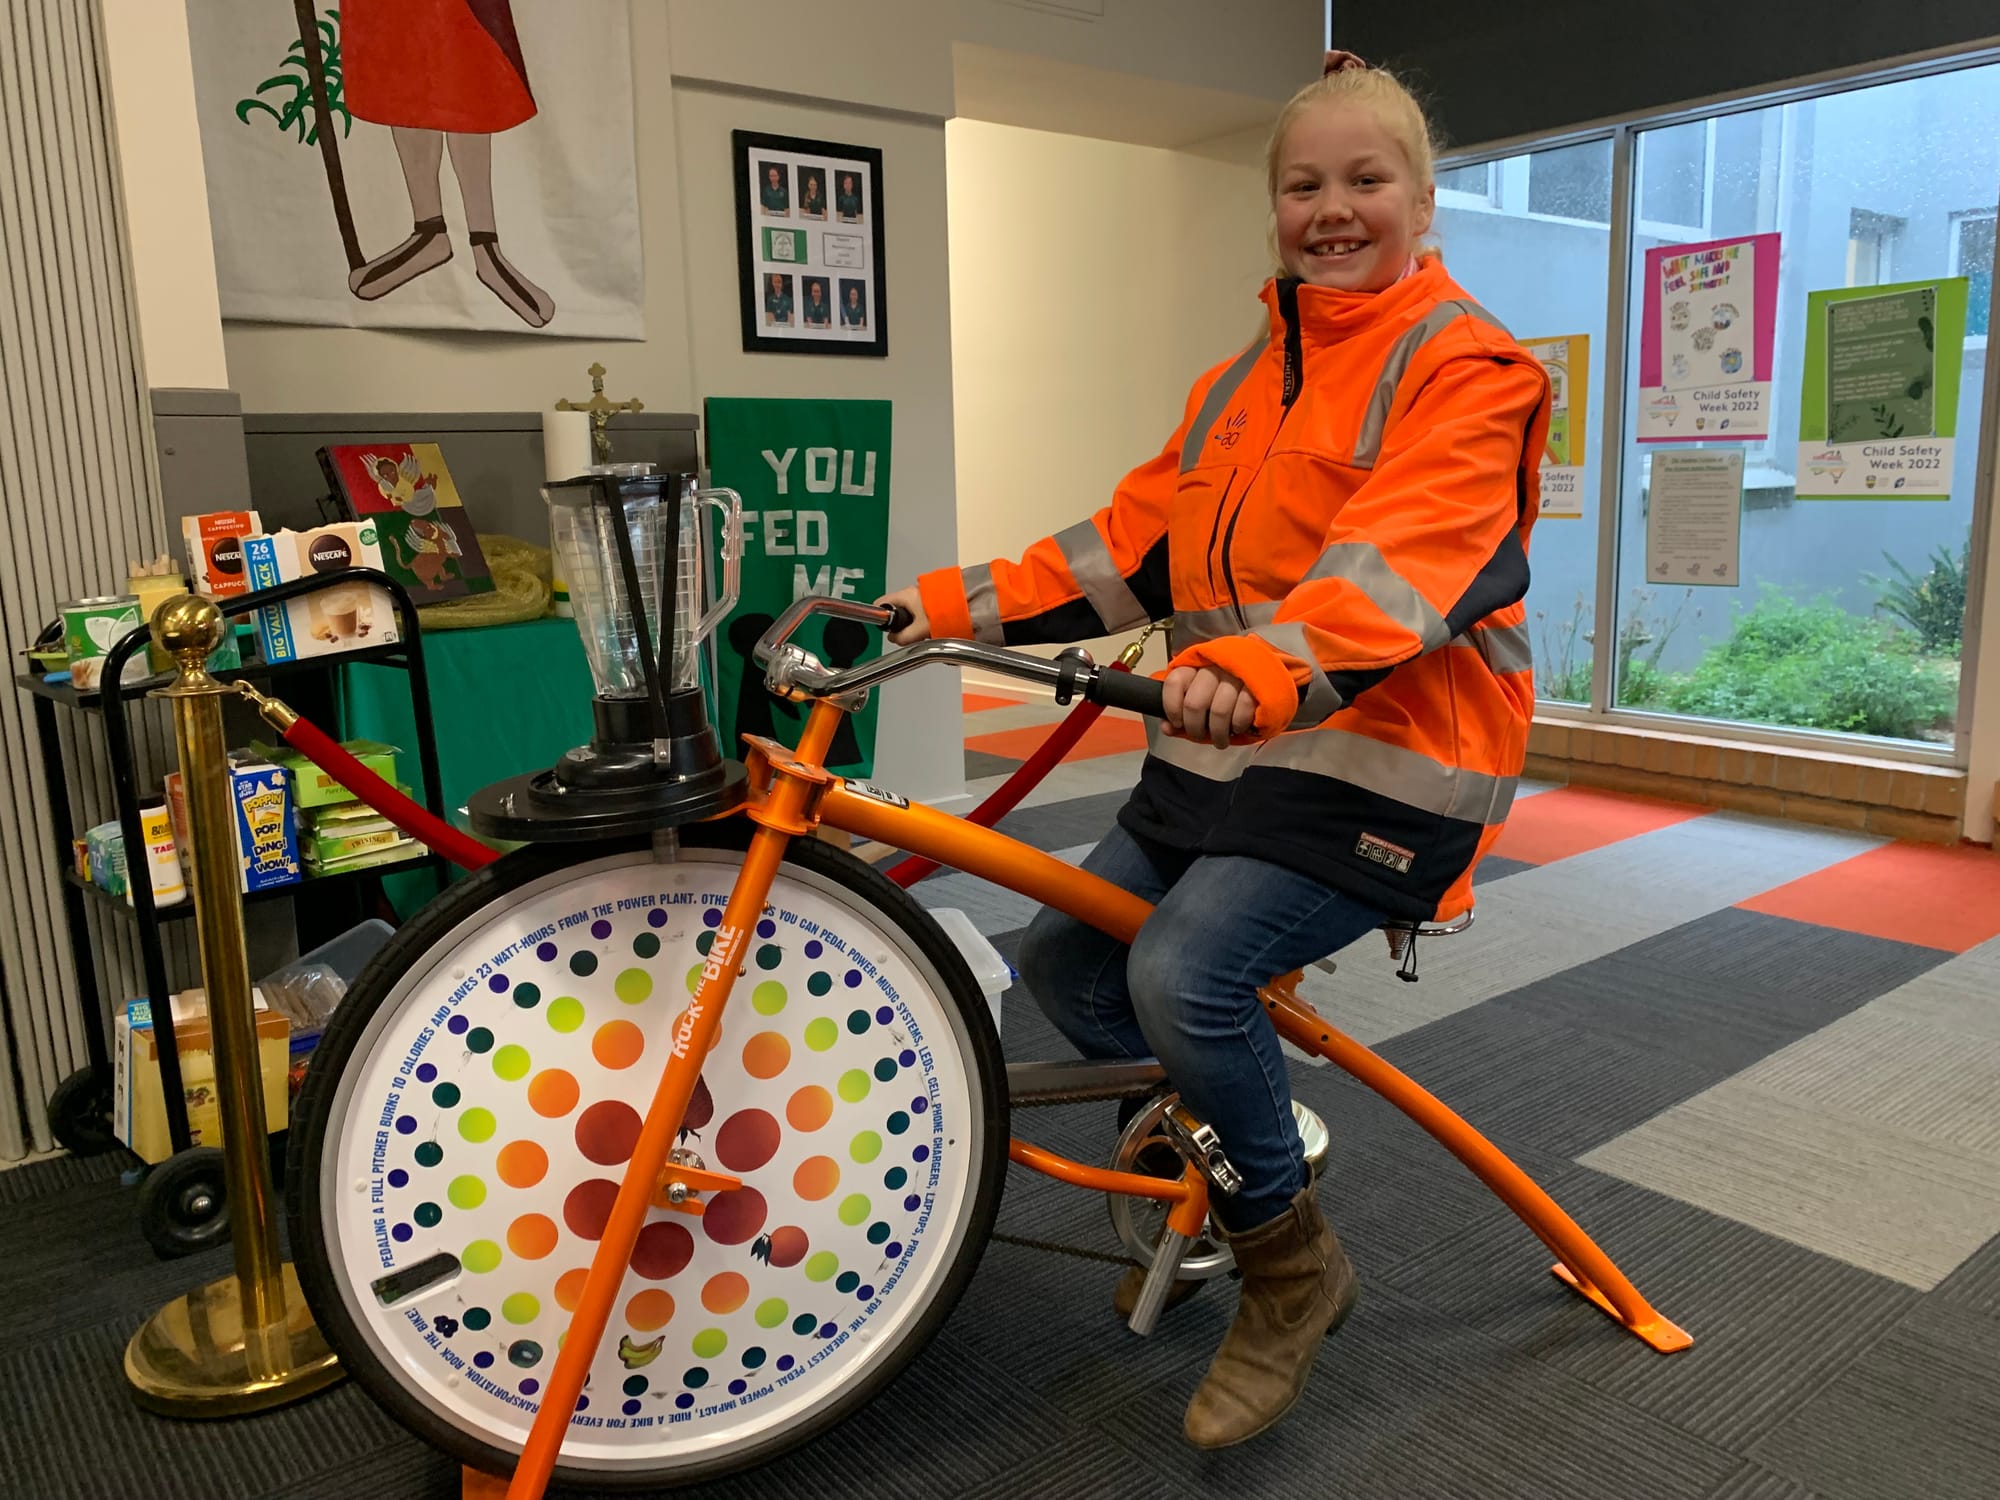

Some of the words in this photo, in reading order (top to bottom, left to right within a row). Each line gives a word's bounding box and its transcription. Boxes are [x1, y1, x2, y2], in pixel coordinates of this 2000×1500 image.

[1693, 390, 1721, 400] Child
[1724, 388, 1760, 400] Safety
[1699, 402, 1728, 412] Week
[1732, 401, 1760, 411] 2022
[1862, 446, 1895, 457] Child
[1900, 445, 1942, 457] Safety
[761, 447, 877, 496] YOU
[1870, 459, 1903, 469] Week
[1909, 459, 1941, 469] 2022
[1545, 472, 1575, 481] Safety
[1552, 483, 1574, 492] 2022
[740, 510, 829, 556] FED
[215, 552, 241, 561] NESCA
[251, 542, 269, 554] 26
[313, 547, 348, 562] NESCAFÉ
[213, 580, 246, 589] CAPPUCC
[259, 562, 272, 588] ACK
[268, 602, 282, 636] VALU
[273, 637, 287, 658] BIG
[254, 823, 281, 838] POP!
[256, 857, 290, 873] WOW!
[617, 895, 656, 912] POWER
[659, 893, 697, 905] PLANT.
[701, 894, 729, 907] OTHE
[557, 910, 589, 931] FROM
[592, 903, 614, 918] THE
[779, 909, 798, 925] YOU
[799, 918, 820, 935] CAN
[491, 923, 556, 967] WATT-HOURS
[819, 928, 848, 954] PEDAL
[476, 963, 493, 979] 23
[847, 948, 878, 979] POWER:
[448, 976, 478, 1006] SAVES
[672, 1003, 704, 1060] ROCK
[703, 925, 736, 981] BIKE
[875, 975, 900, 1003] MUSIC
[430, 1005, 451, 1028] AND
[896, 1002, 923, 1047] SYSTEMS,
[400, 1026, 435, 1076] CALORIES
[918, 1046, 934, 1076] LEDS,
[392, 1076, 407, 1089] 10
[927, 1076, 941, 1101] CELL
[379, 1092, 400, 1128] BURNS
[932, 1103, 943, 1134] PHONE
[372, 1131, 389, 1173] PITCHER
[926, 1137, 943, 1189] CHARGERS,
[372, 1177, 384, 1203] FULL
[912, 1193, 936, 1236] LAPTOPS,
[374, 1218, 395, 1268] PEDALING
[864, 1297, 882, 1315] FOR
[404, 1307, 430, 1333] BIKE!
[848, 1315, 867, 1333] THE
[423, 1330, 443, 1350] THE
[807, 1330, 850, 1369] GREATEST
[439, 1347, 466, 1371] ROCK
[776, 1365, 806, 1387] PEDAL
[464, 1366, 541, 1414] RANSPORTATION.
[739, 1384, 775, 1406] POWER
[668, 1411, 692, 1424] RIDE
[694, 1399, 738, 1418] IMPACT,
[605, 1417, 626, 1428] FOR
[630, 1416, 653, 1428] BIKE
[657, 1415, 665, 1425] A
